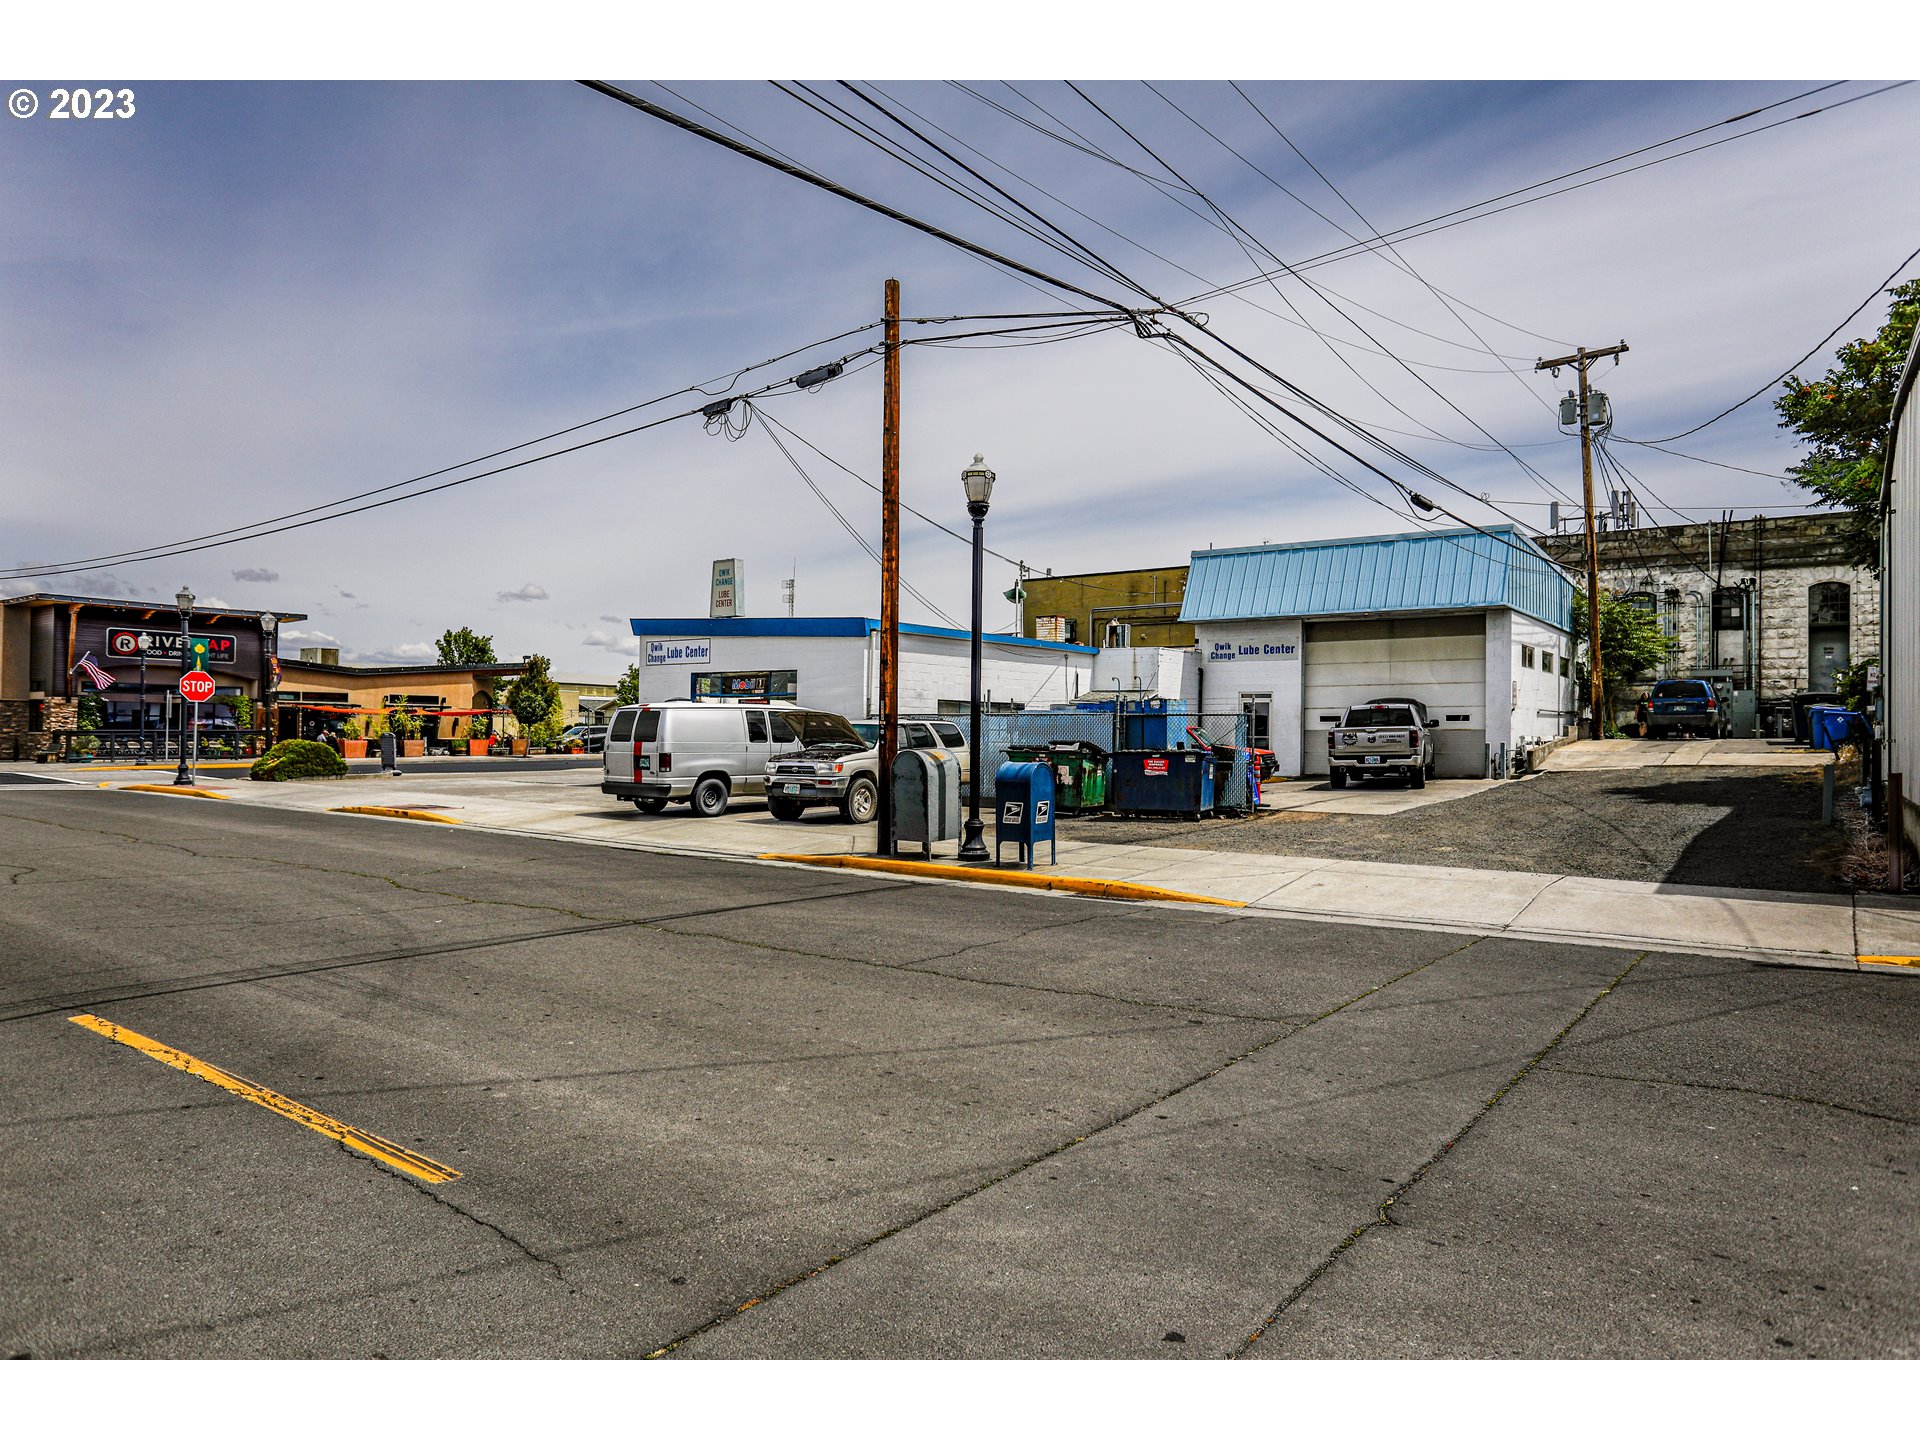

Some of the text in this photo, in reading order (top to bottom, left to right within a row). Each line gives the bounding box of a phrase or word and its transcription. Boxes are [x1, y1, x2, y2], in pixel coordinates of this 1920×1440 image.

[716, 577, 733, 586] CHANGE
[718, 590, 730, 598] LUBE
[715, 599, 733, 607] CENTER
[650, 642, 663, 653] Qwik
[667, 645, 708, 659] Lube Center
[1214, 642, 1232, 652] Qwik
[1238, 643, 1295, 655] Lube Center
[648, 653, 666, 663] Change
[1210, 651, 1236, 660] Change
[182, 680, 213, 693] STOP
[731, 678, 756, 690] Mobil
